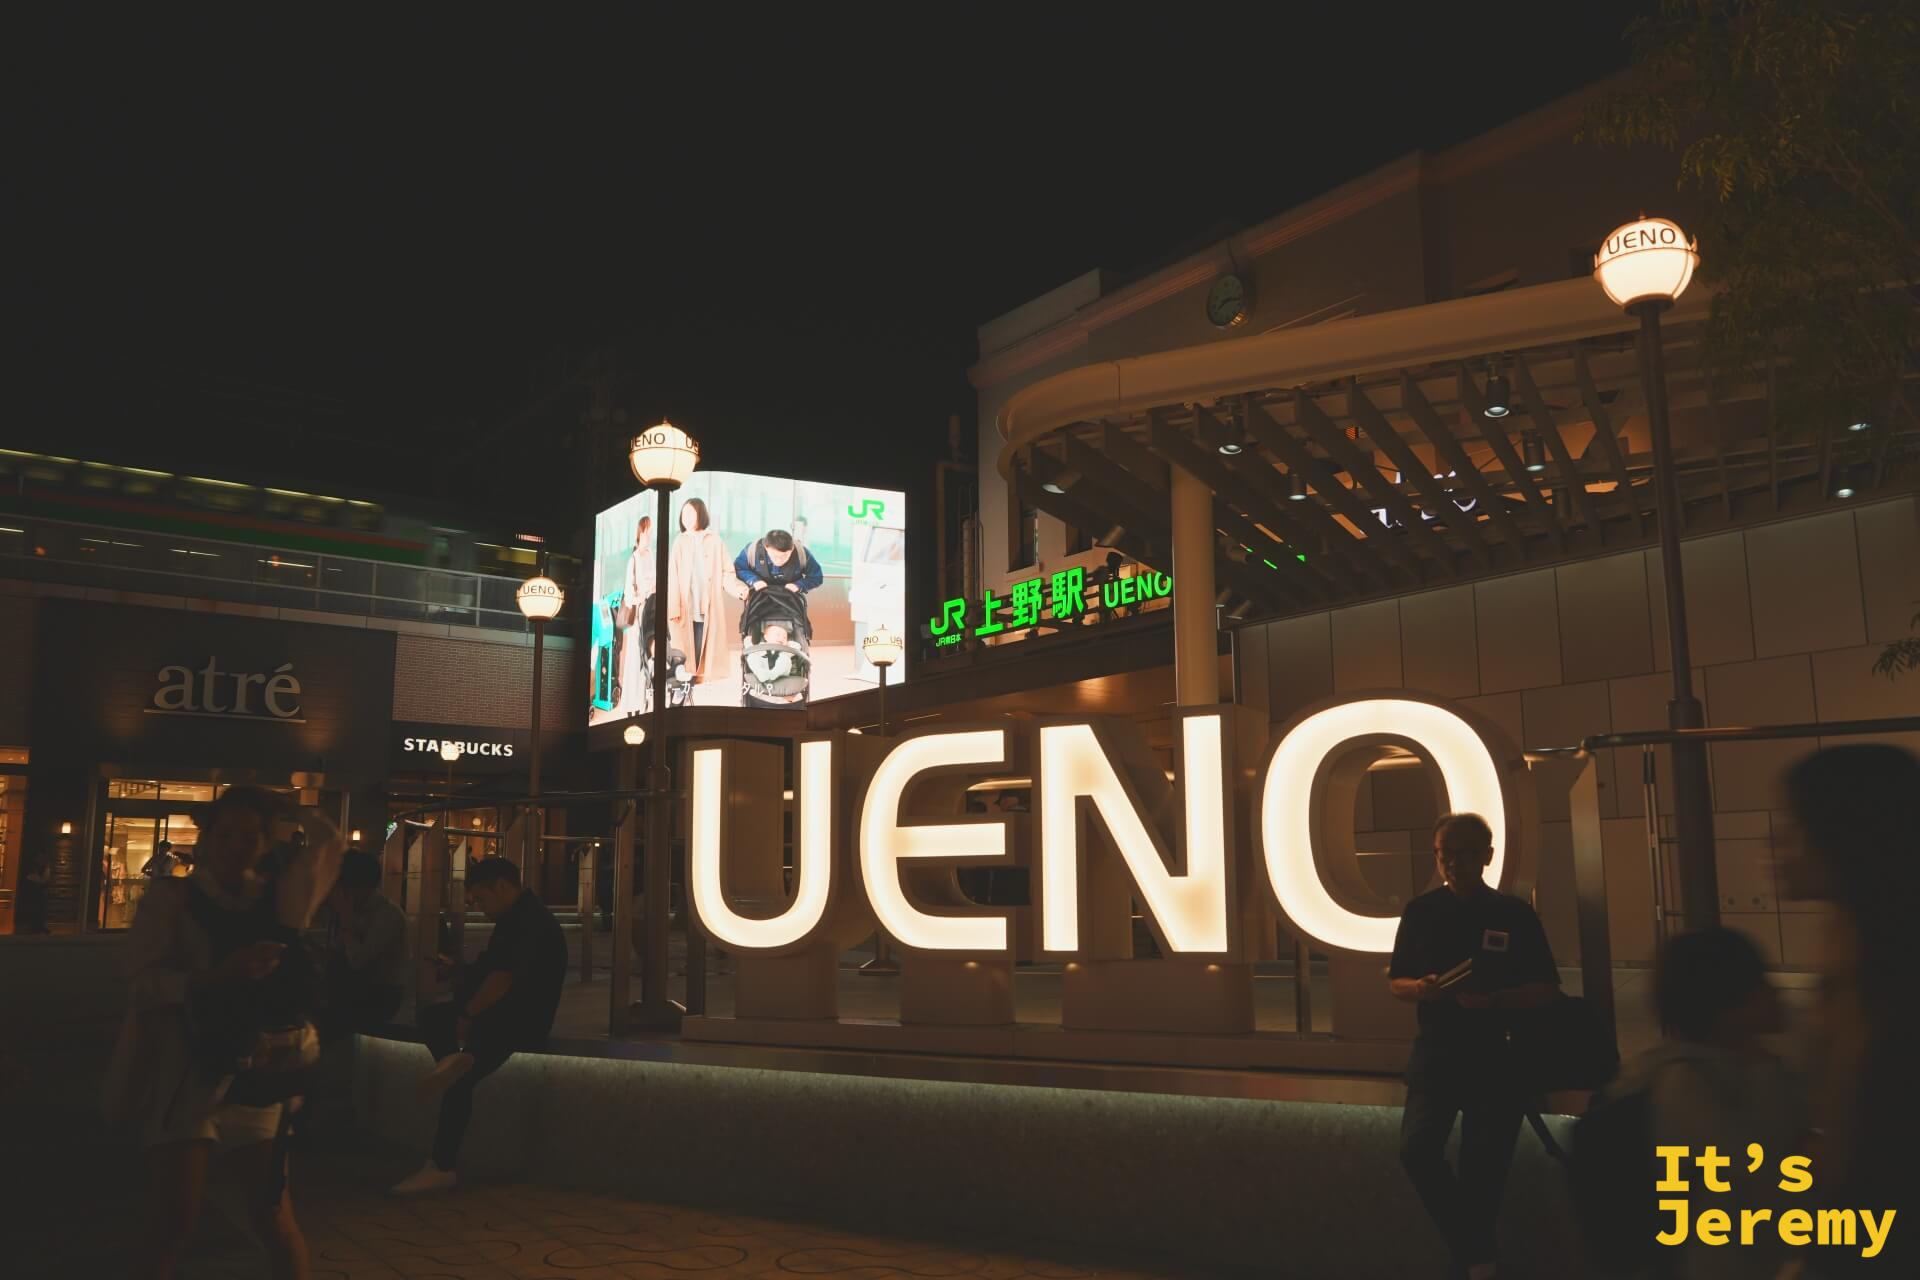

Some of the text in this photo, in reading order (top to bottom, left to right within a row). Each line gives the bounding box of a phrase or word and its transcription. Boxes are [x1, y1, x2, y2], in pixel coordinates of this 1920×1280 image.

[1607, 227, 1676, 255] UENO
[631, 432, 666, 448] ENO
[847, 499, 885, 521] JR
[522, 585, 555, 595] UENO
[930, 566, 1172, 636] JR 上野駅 UENO
[154, 655, 301, 718] atré
[692, 700, 1506, 953] UENO
